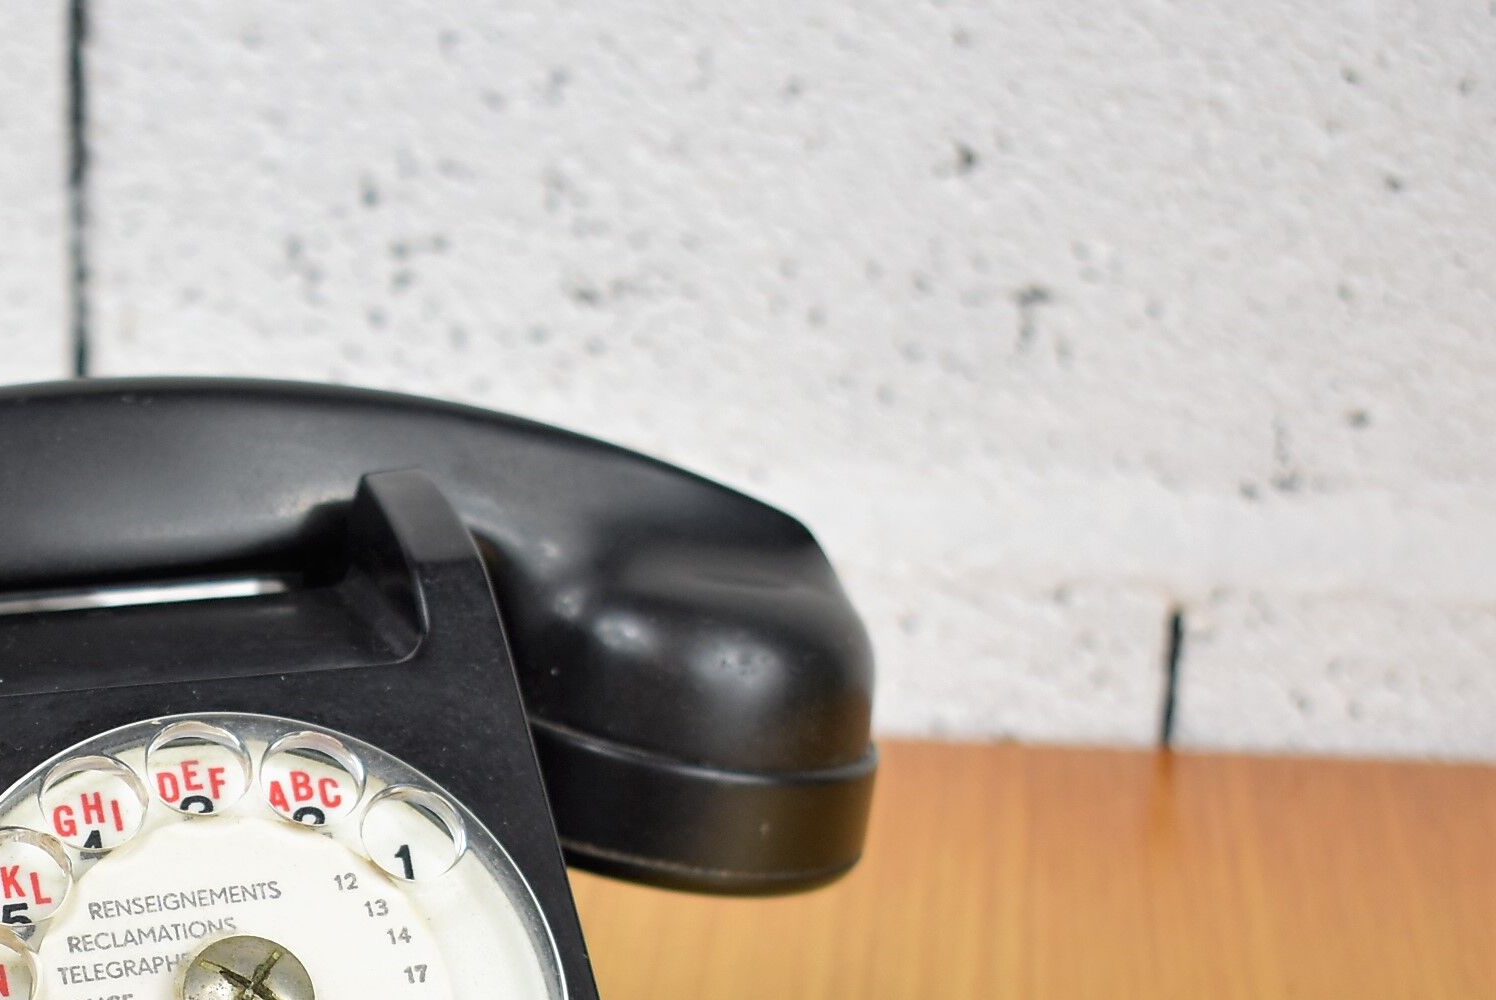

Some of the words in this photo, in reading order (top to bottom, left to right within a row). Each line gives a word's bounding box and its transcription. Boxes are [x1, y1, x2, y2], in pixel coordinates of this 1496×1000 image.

[156, 760, 225, 804] DEF
[268, 770, 342, 813] ABC
[53, 791, 123, 837] GHI
[394, 844, 415, 880] 1
[333, 872, 359, 891] 12
[88, 881, 282, 920] RENSEIGNEMENTS
[364, 899, 389, 917] 13
[66, 917, 237, 953] RECLAMATIONS
[386, 927, 412, 945] 14
[403, 964, 428, 984] 17
